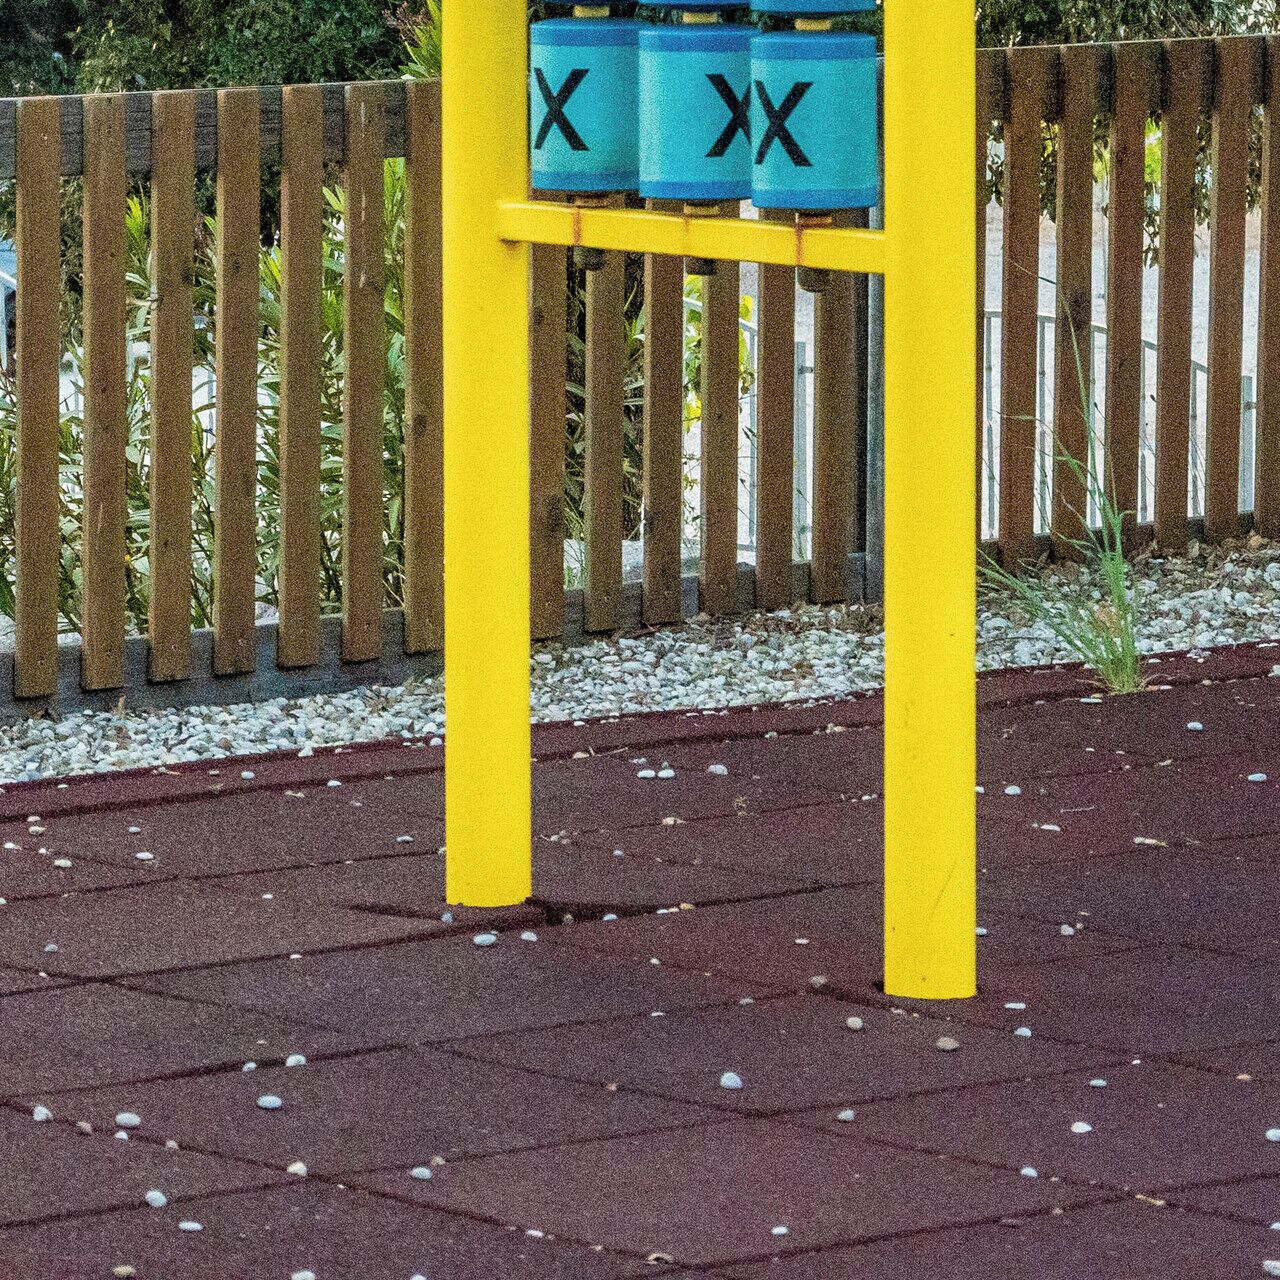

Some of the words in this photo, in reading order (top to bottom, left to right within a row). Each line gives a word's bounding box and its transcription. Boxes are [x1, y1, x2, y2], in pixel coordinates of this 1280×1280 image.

[534, 68, 589, 151] X
[705, 73, 751, 157] X
[754, 80, 813, 167] X
